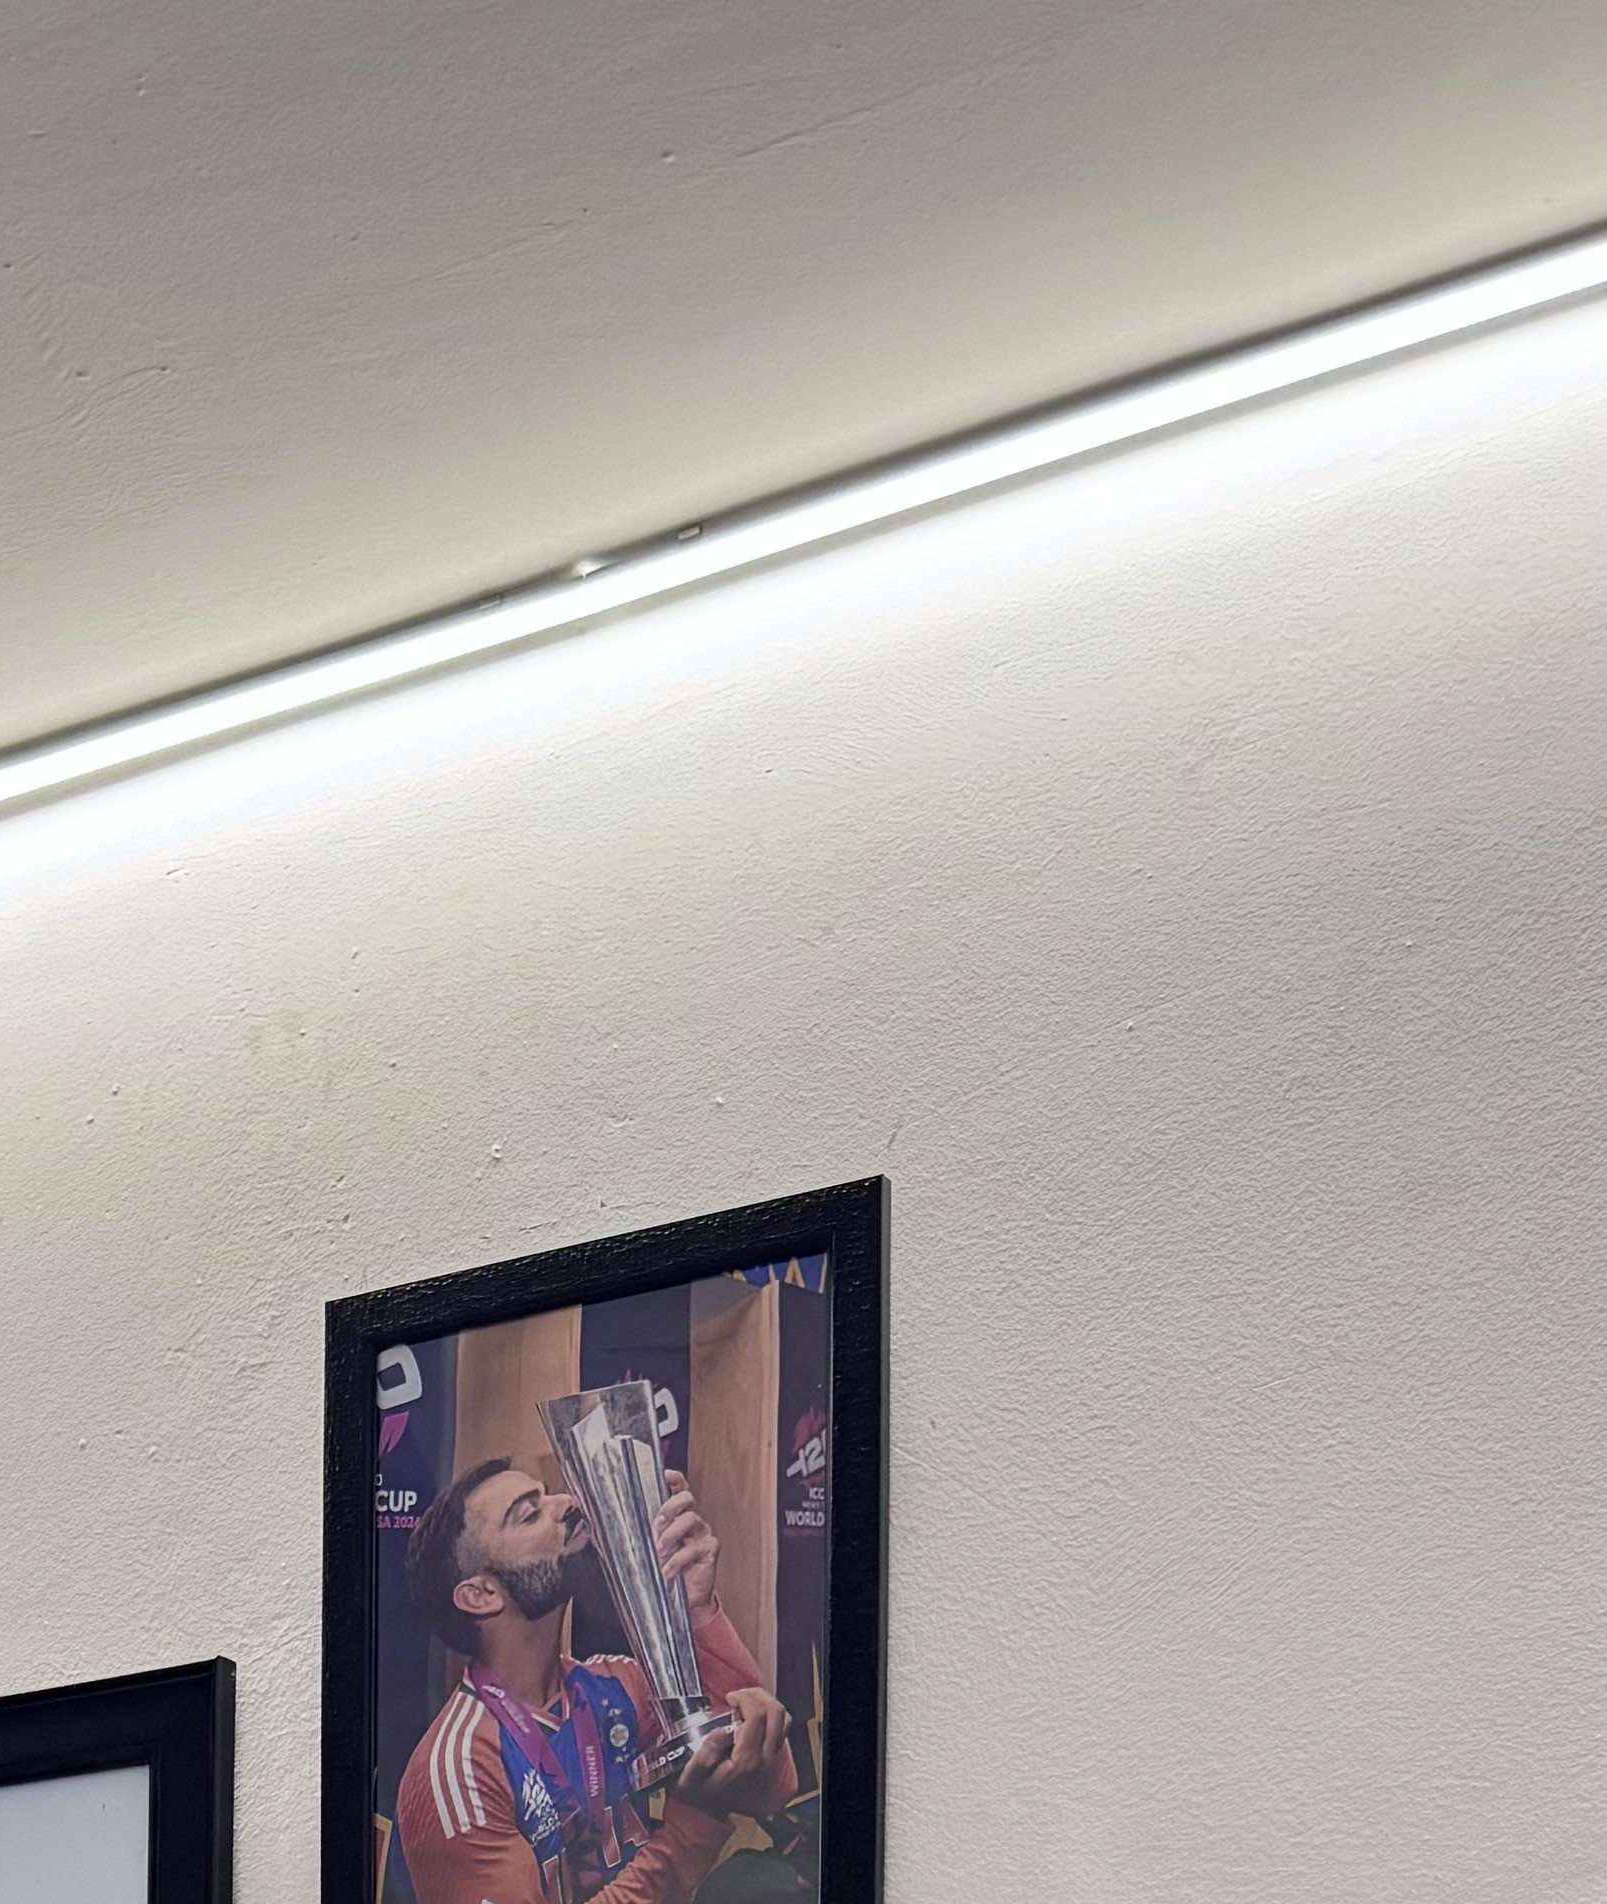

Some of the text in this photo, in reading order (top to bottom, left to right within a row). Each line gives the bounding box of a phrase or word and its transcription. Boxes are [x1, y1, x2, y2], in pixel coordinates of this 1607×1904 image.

[376, 1490, 418, 1513] CUP
[785, 1509, 825, 1527] WORLD
[585, 1745, 599, 1798] WINNER
